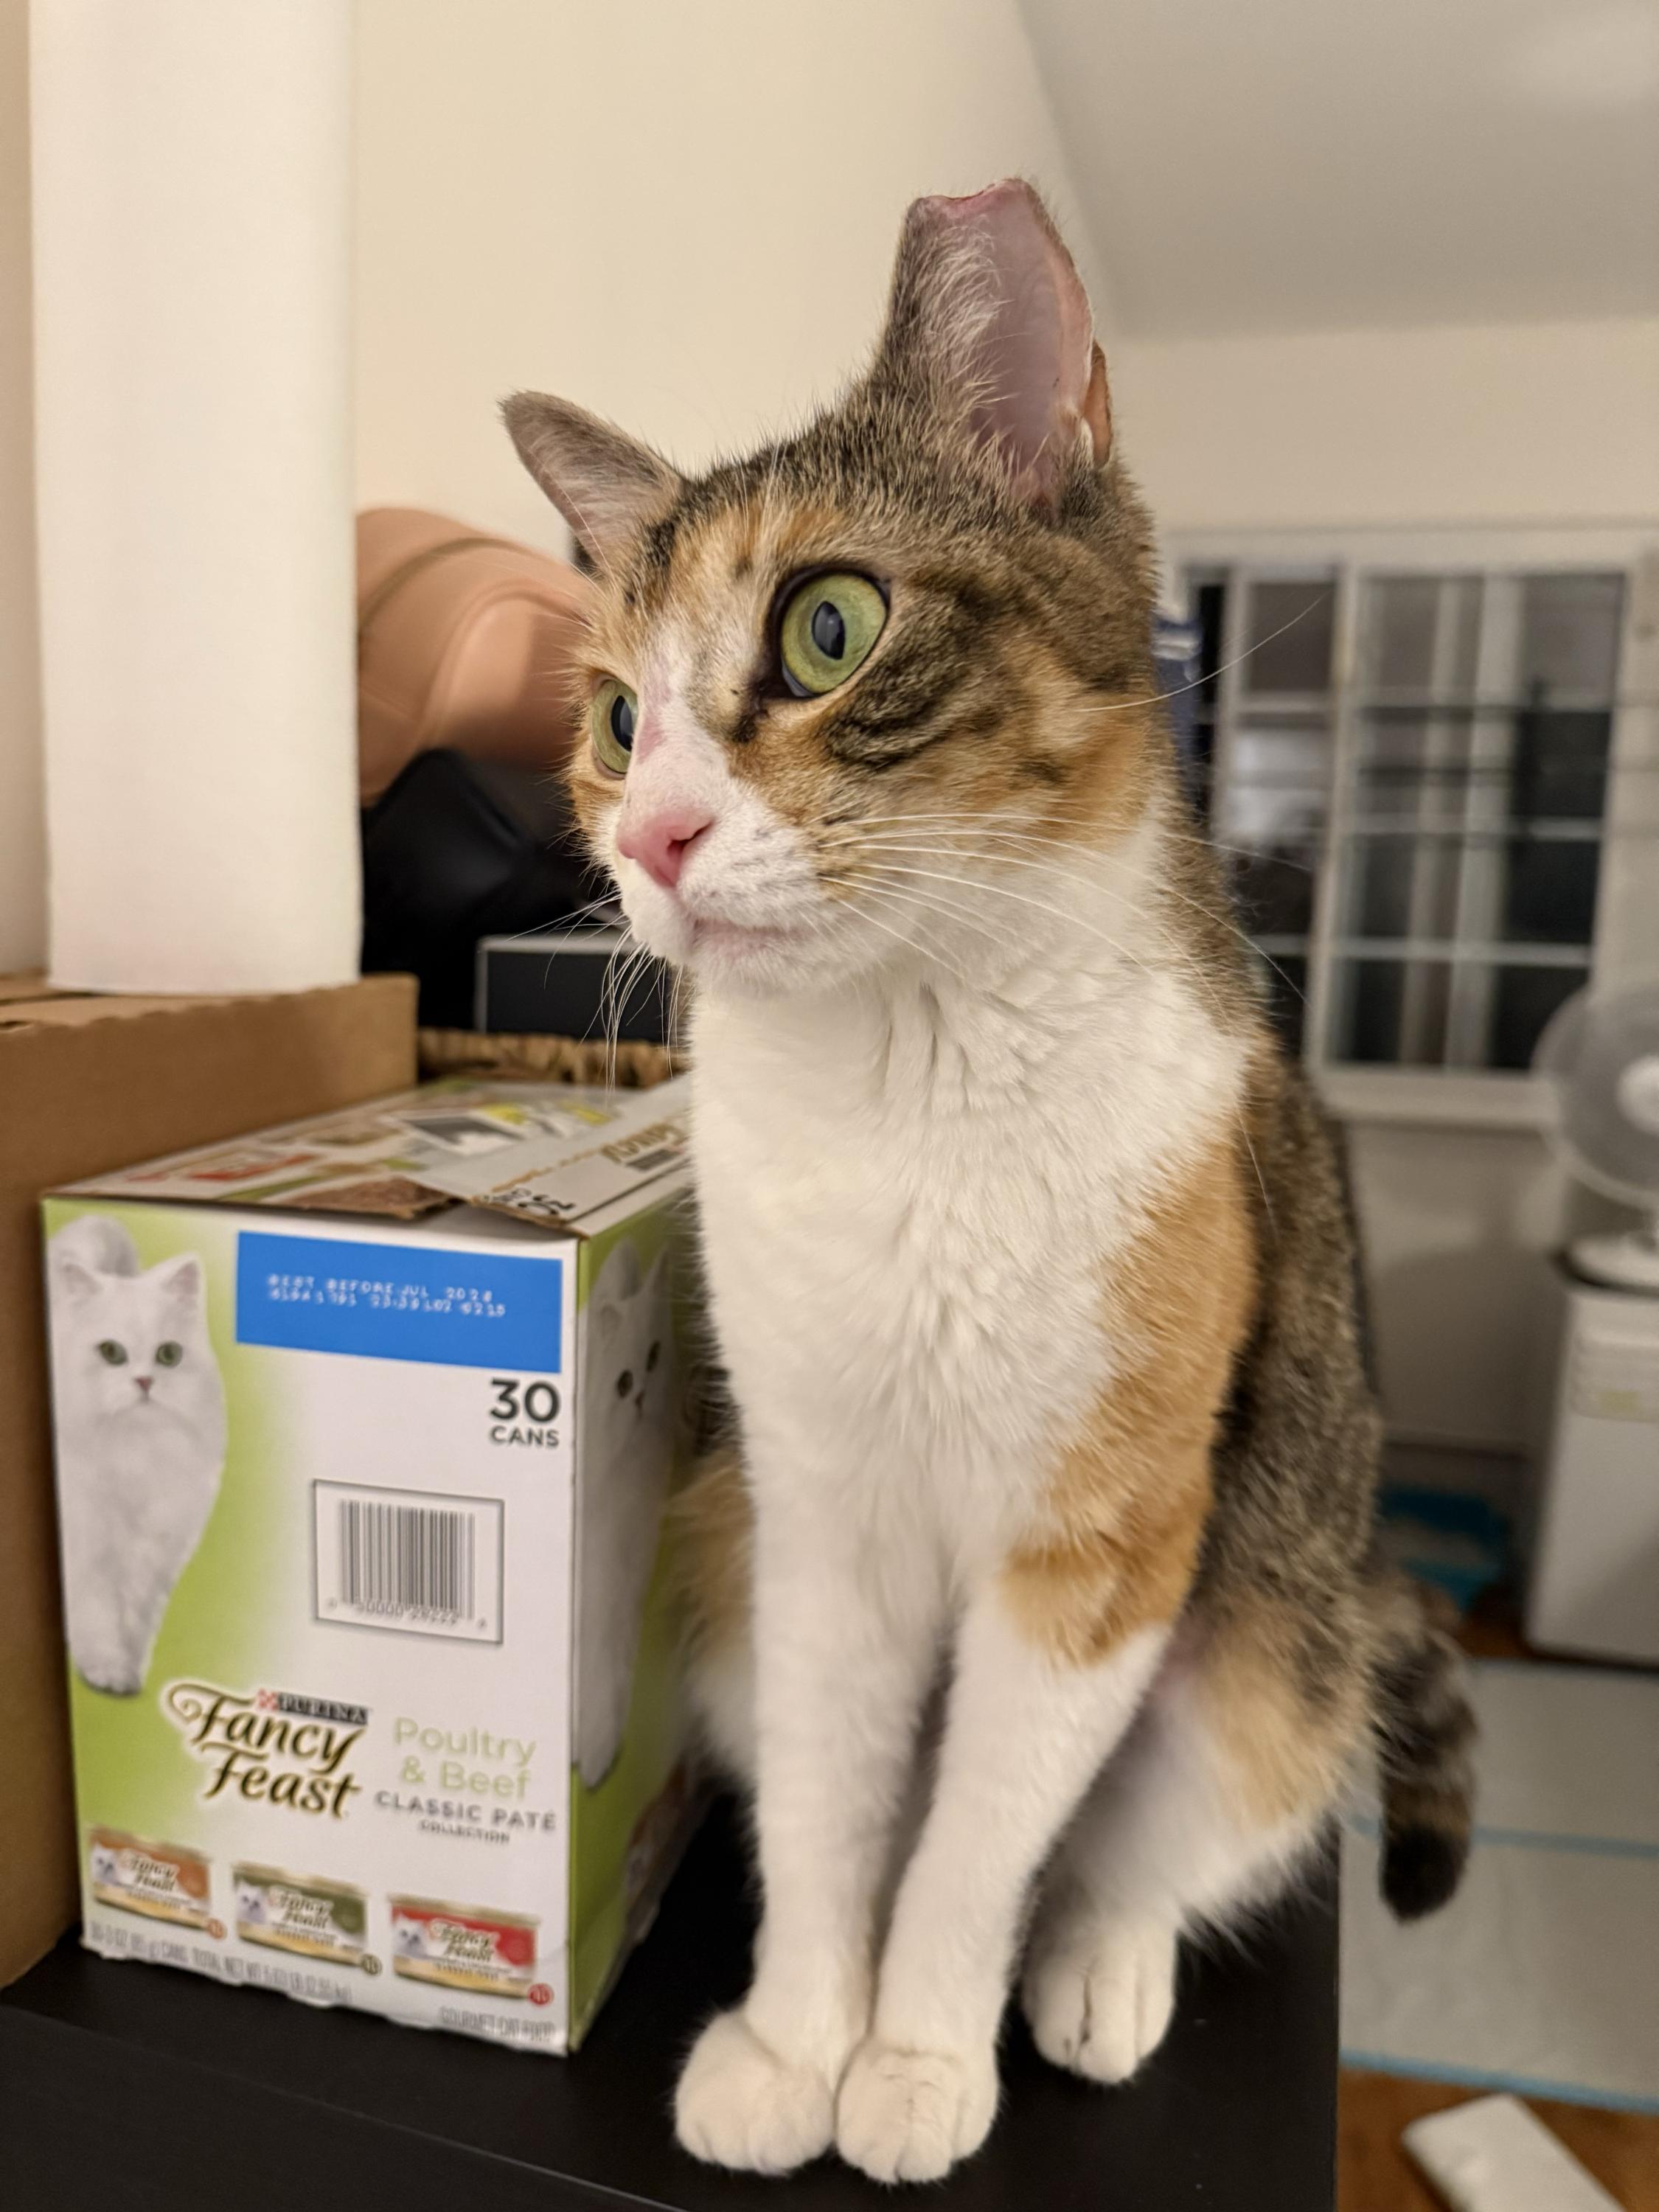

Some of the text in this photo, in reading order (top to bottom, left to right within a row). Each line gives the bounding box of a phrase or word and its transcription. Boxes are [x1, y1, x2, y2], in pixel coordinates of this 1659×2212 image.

[327, 1277, 394, 1295] BEFORE
[490, 1377, 560, 1423] 30
[490, 1425, 560, 1447] CANS
[167, 1683, 366, 1775] Fancy
[394, 1717, 536, 1767] Poultry
[200, 1742, 363, 1820] Feast
[402, 1754, 530, 1801] & Beef
[375, 1790, 483, 1822] CLASSIC
